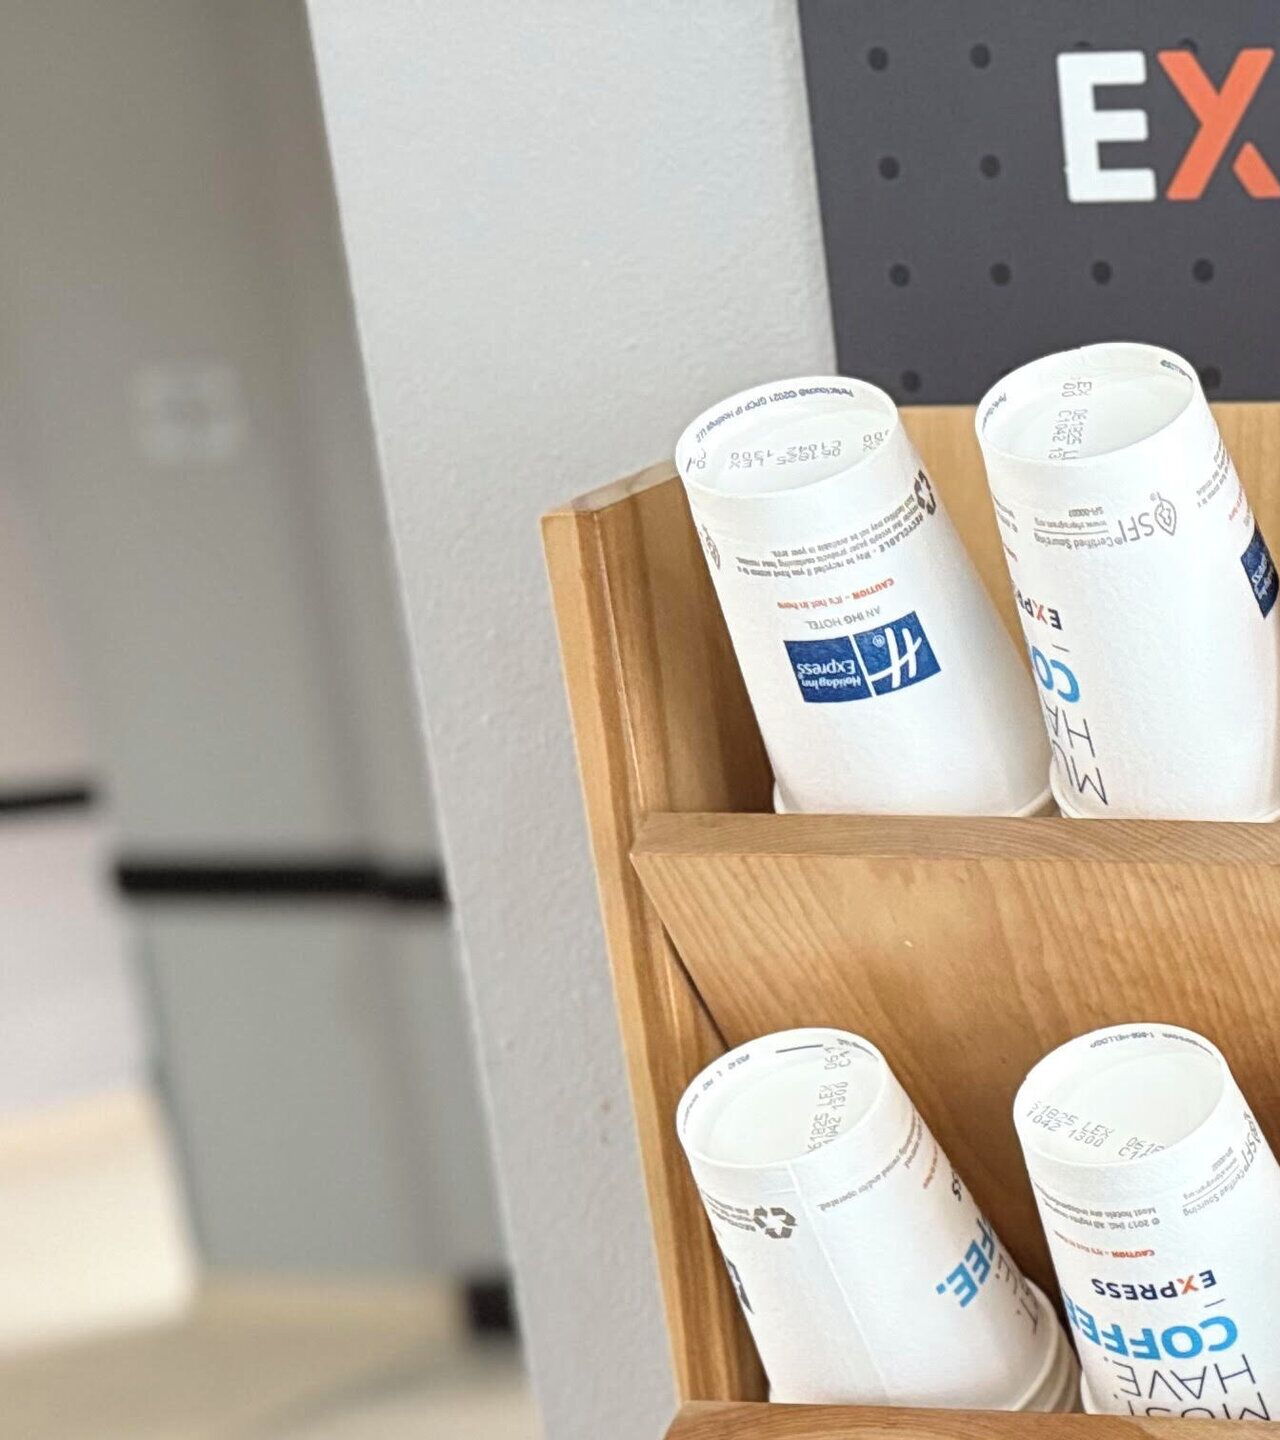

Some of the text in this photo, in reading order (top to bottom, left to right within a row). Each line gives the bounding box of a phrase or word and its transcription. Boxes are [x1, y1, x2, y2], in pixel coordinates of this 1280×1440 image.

[853, 578, 895, 601] CAUTION
[846, 611, 864, 624] IHG
[797, 662, 856, 680] Express
[1092, 1268, 1217, 1302] EXPRESS
